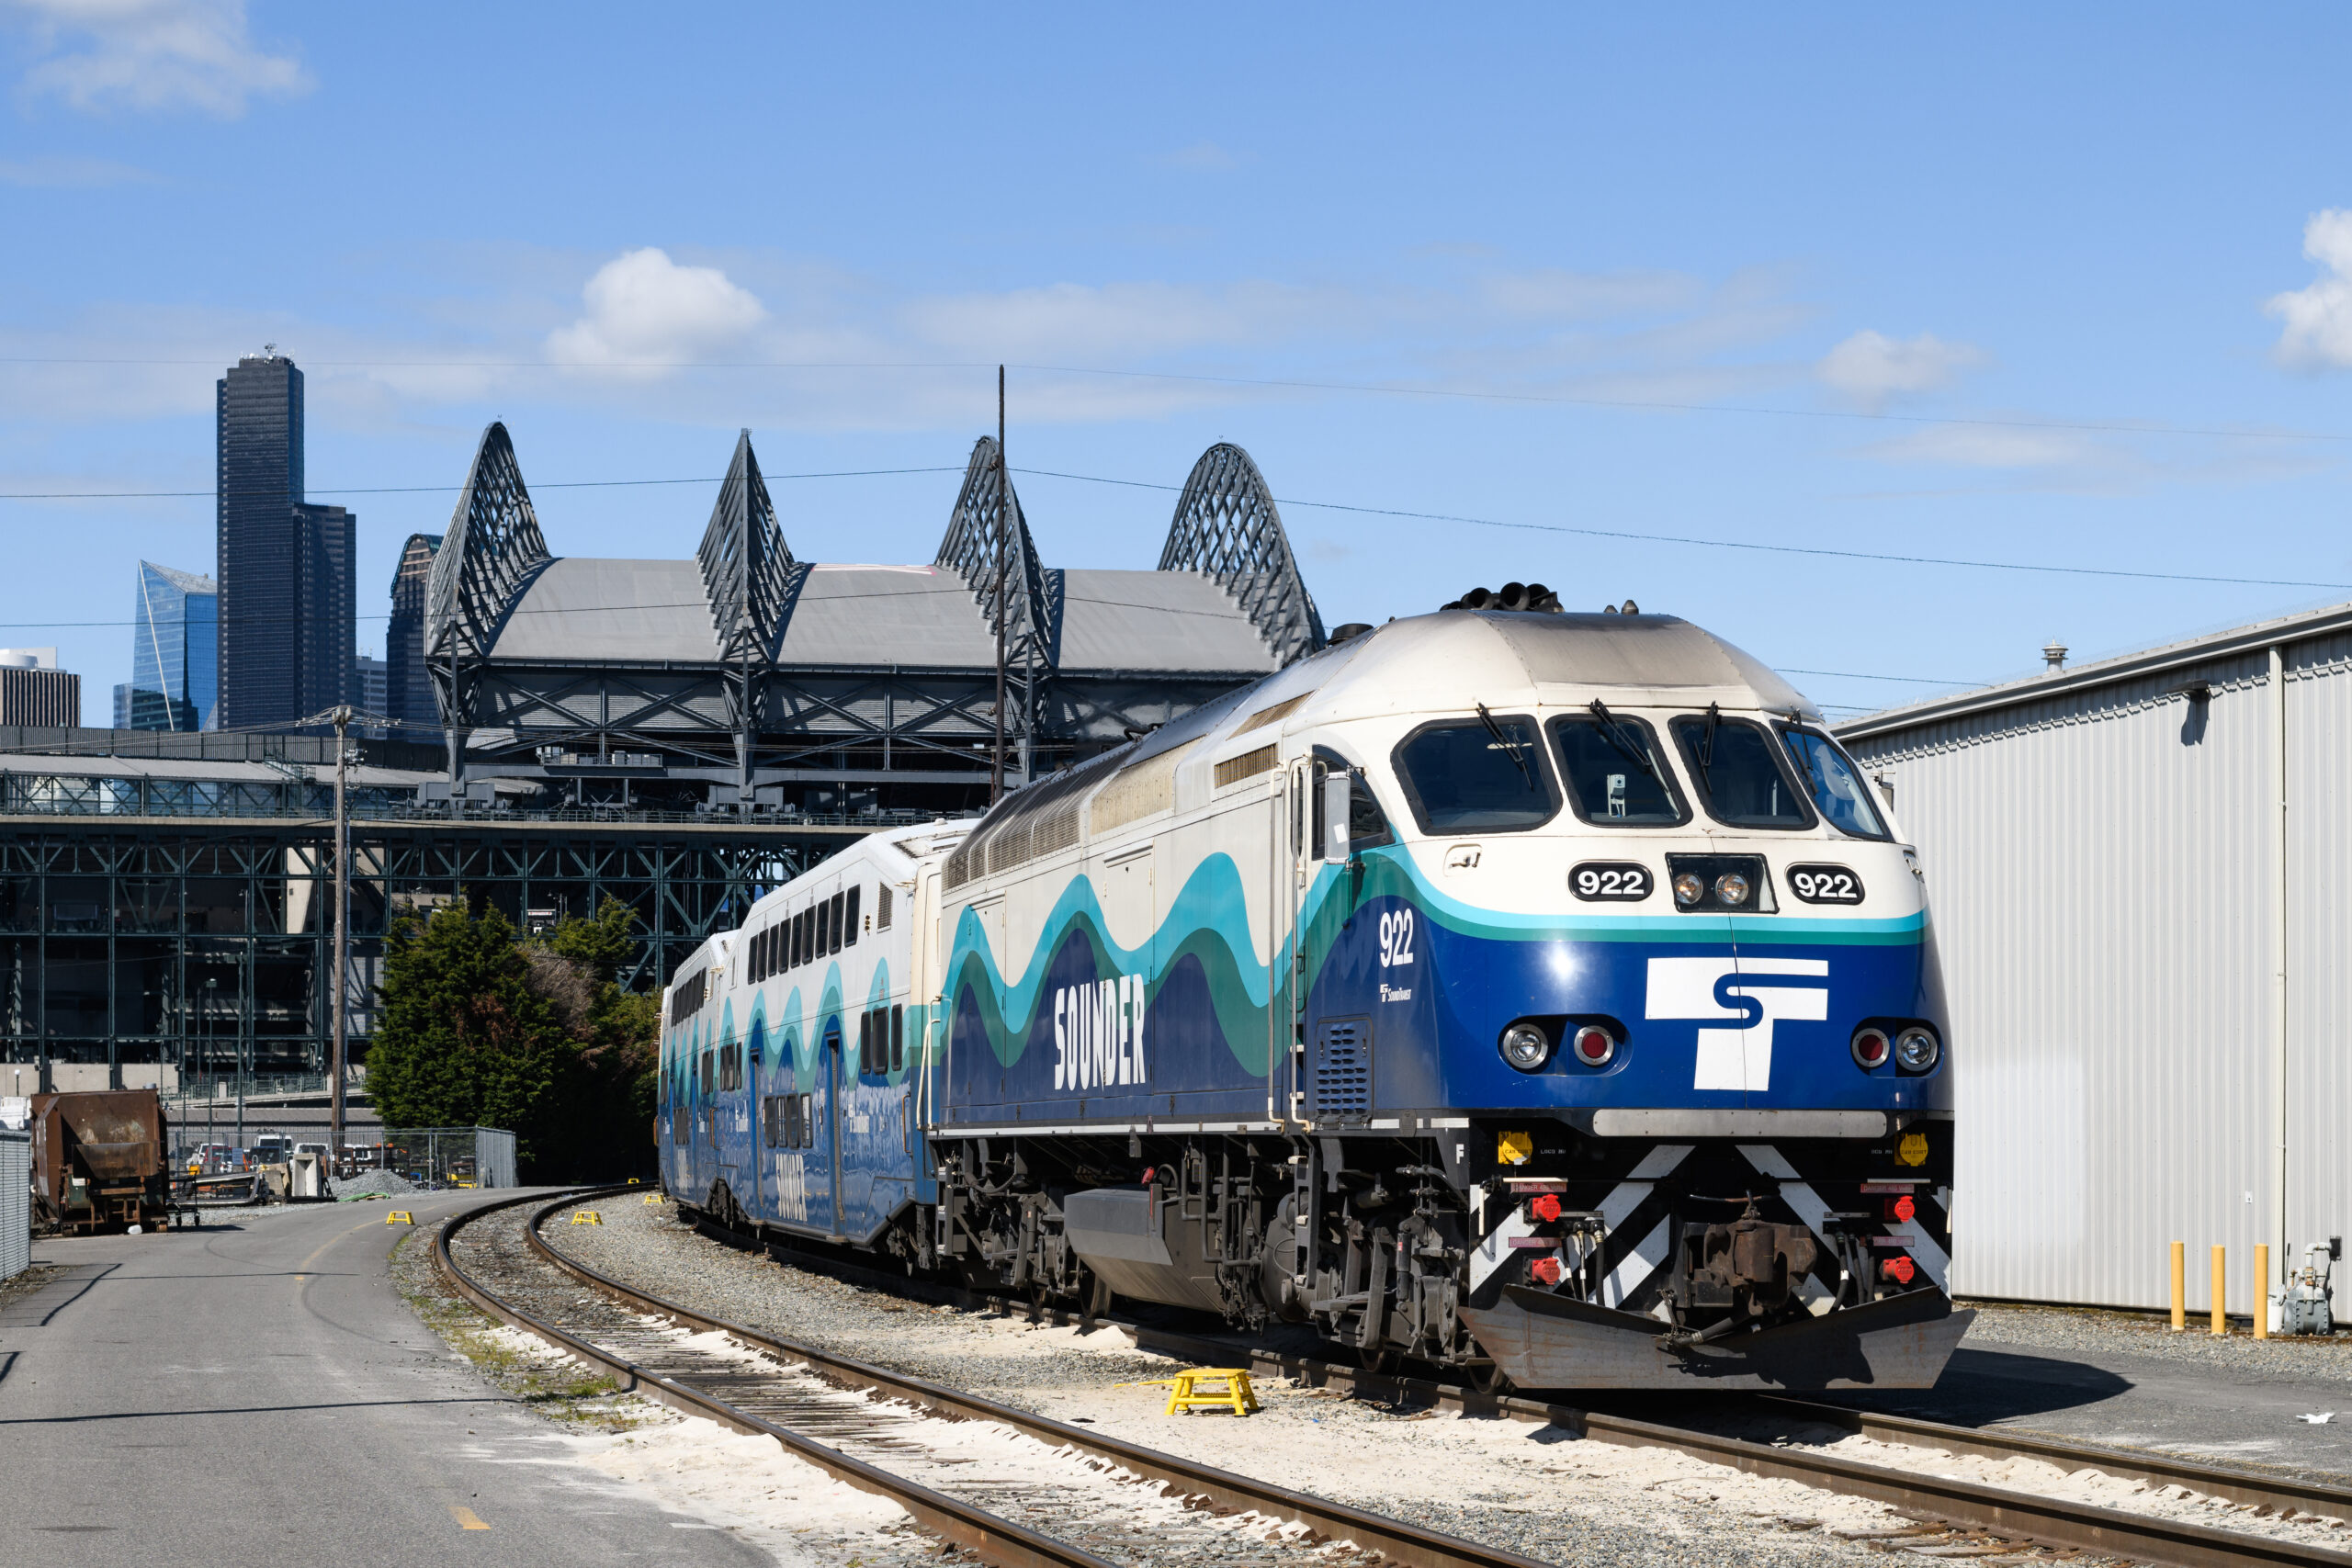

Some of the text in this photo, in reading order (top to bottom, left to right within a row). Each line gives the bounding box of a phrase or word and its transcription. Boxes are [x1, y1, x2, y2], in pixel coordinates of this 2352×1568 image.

[1577, 871, 1645, 896] 922
[1794, 873, 1858, 898] 922
[1379, 908, 1414, 968] 922
[1054, 973, 1146, 1092] SOUNDER
[1455, 1144, 1464, 1164] F
